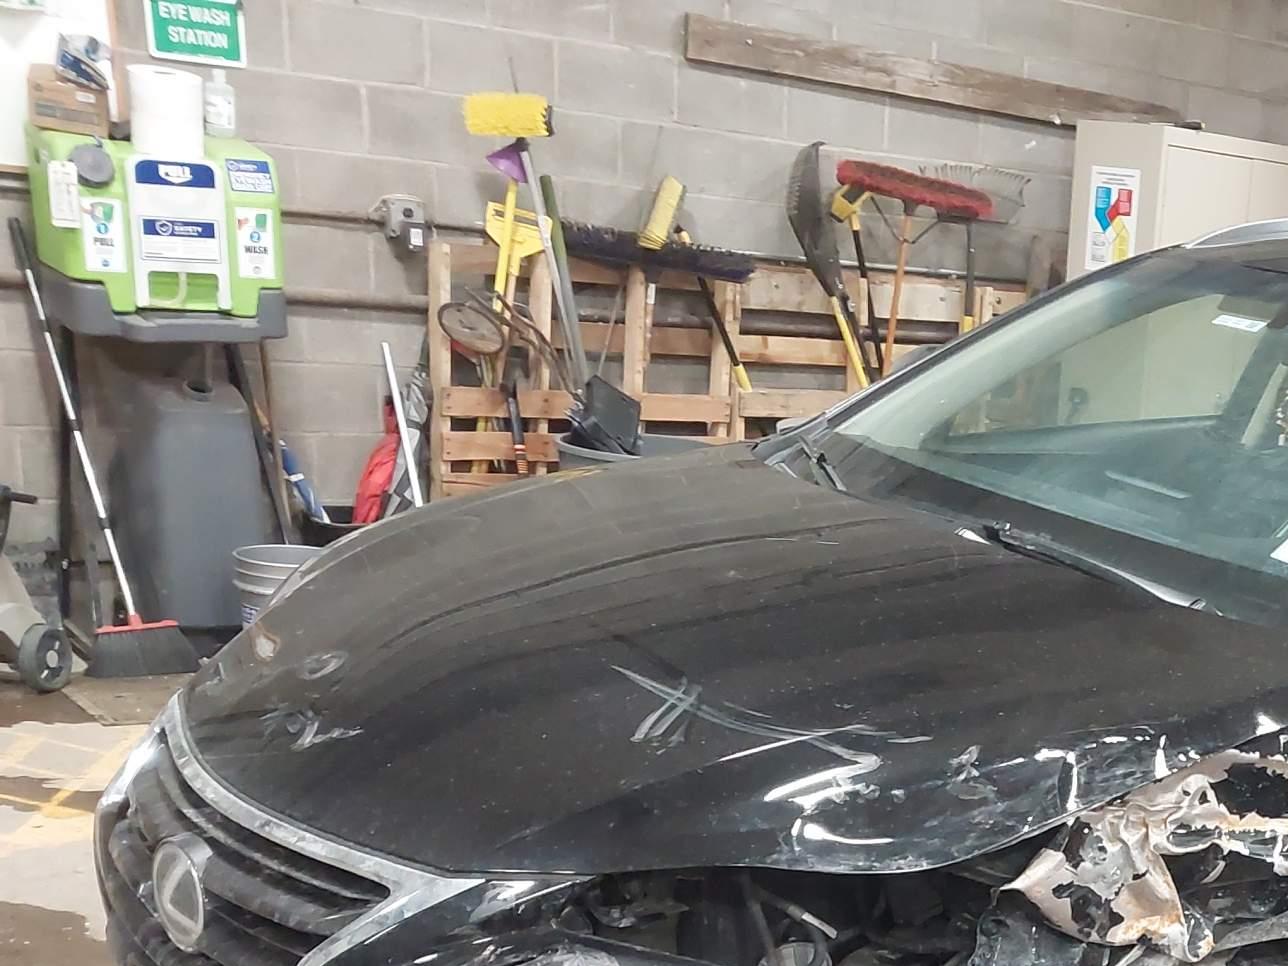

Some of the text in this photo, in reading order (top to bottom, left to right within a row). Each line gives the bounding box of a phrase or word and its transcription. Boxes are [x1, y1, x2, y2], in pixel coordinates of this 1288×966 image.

[158, 1, 231, 27] EYE WASH
[167, 25, 229, 49] STATION
